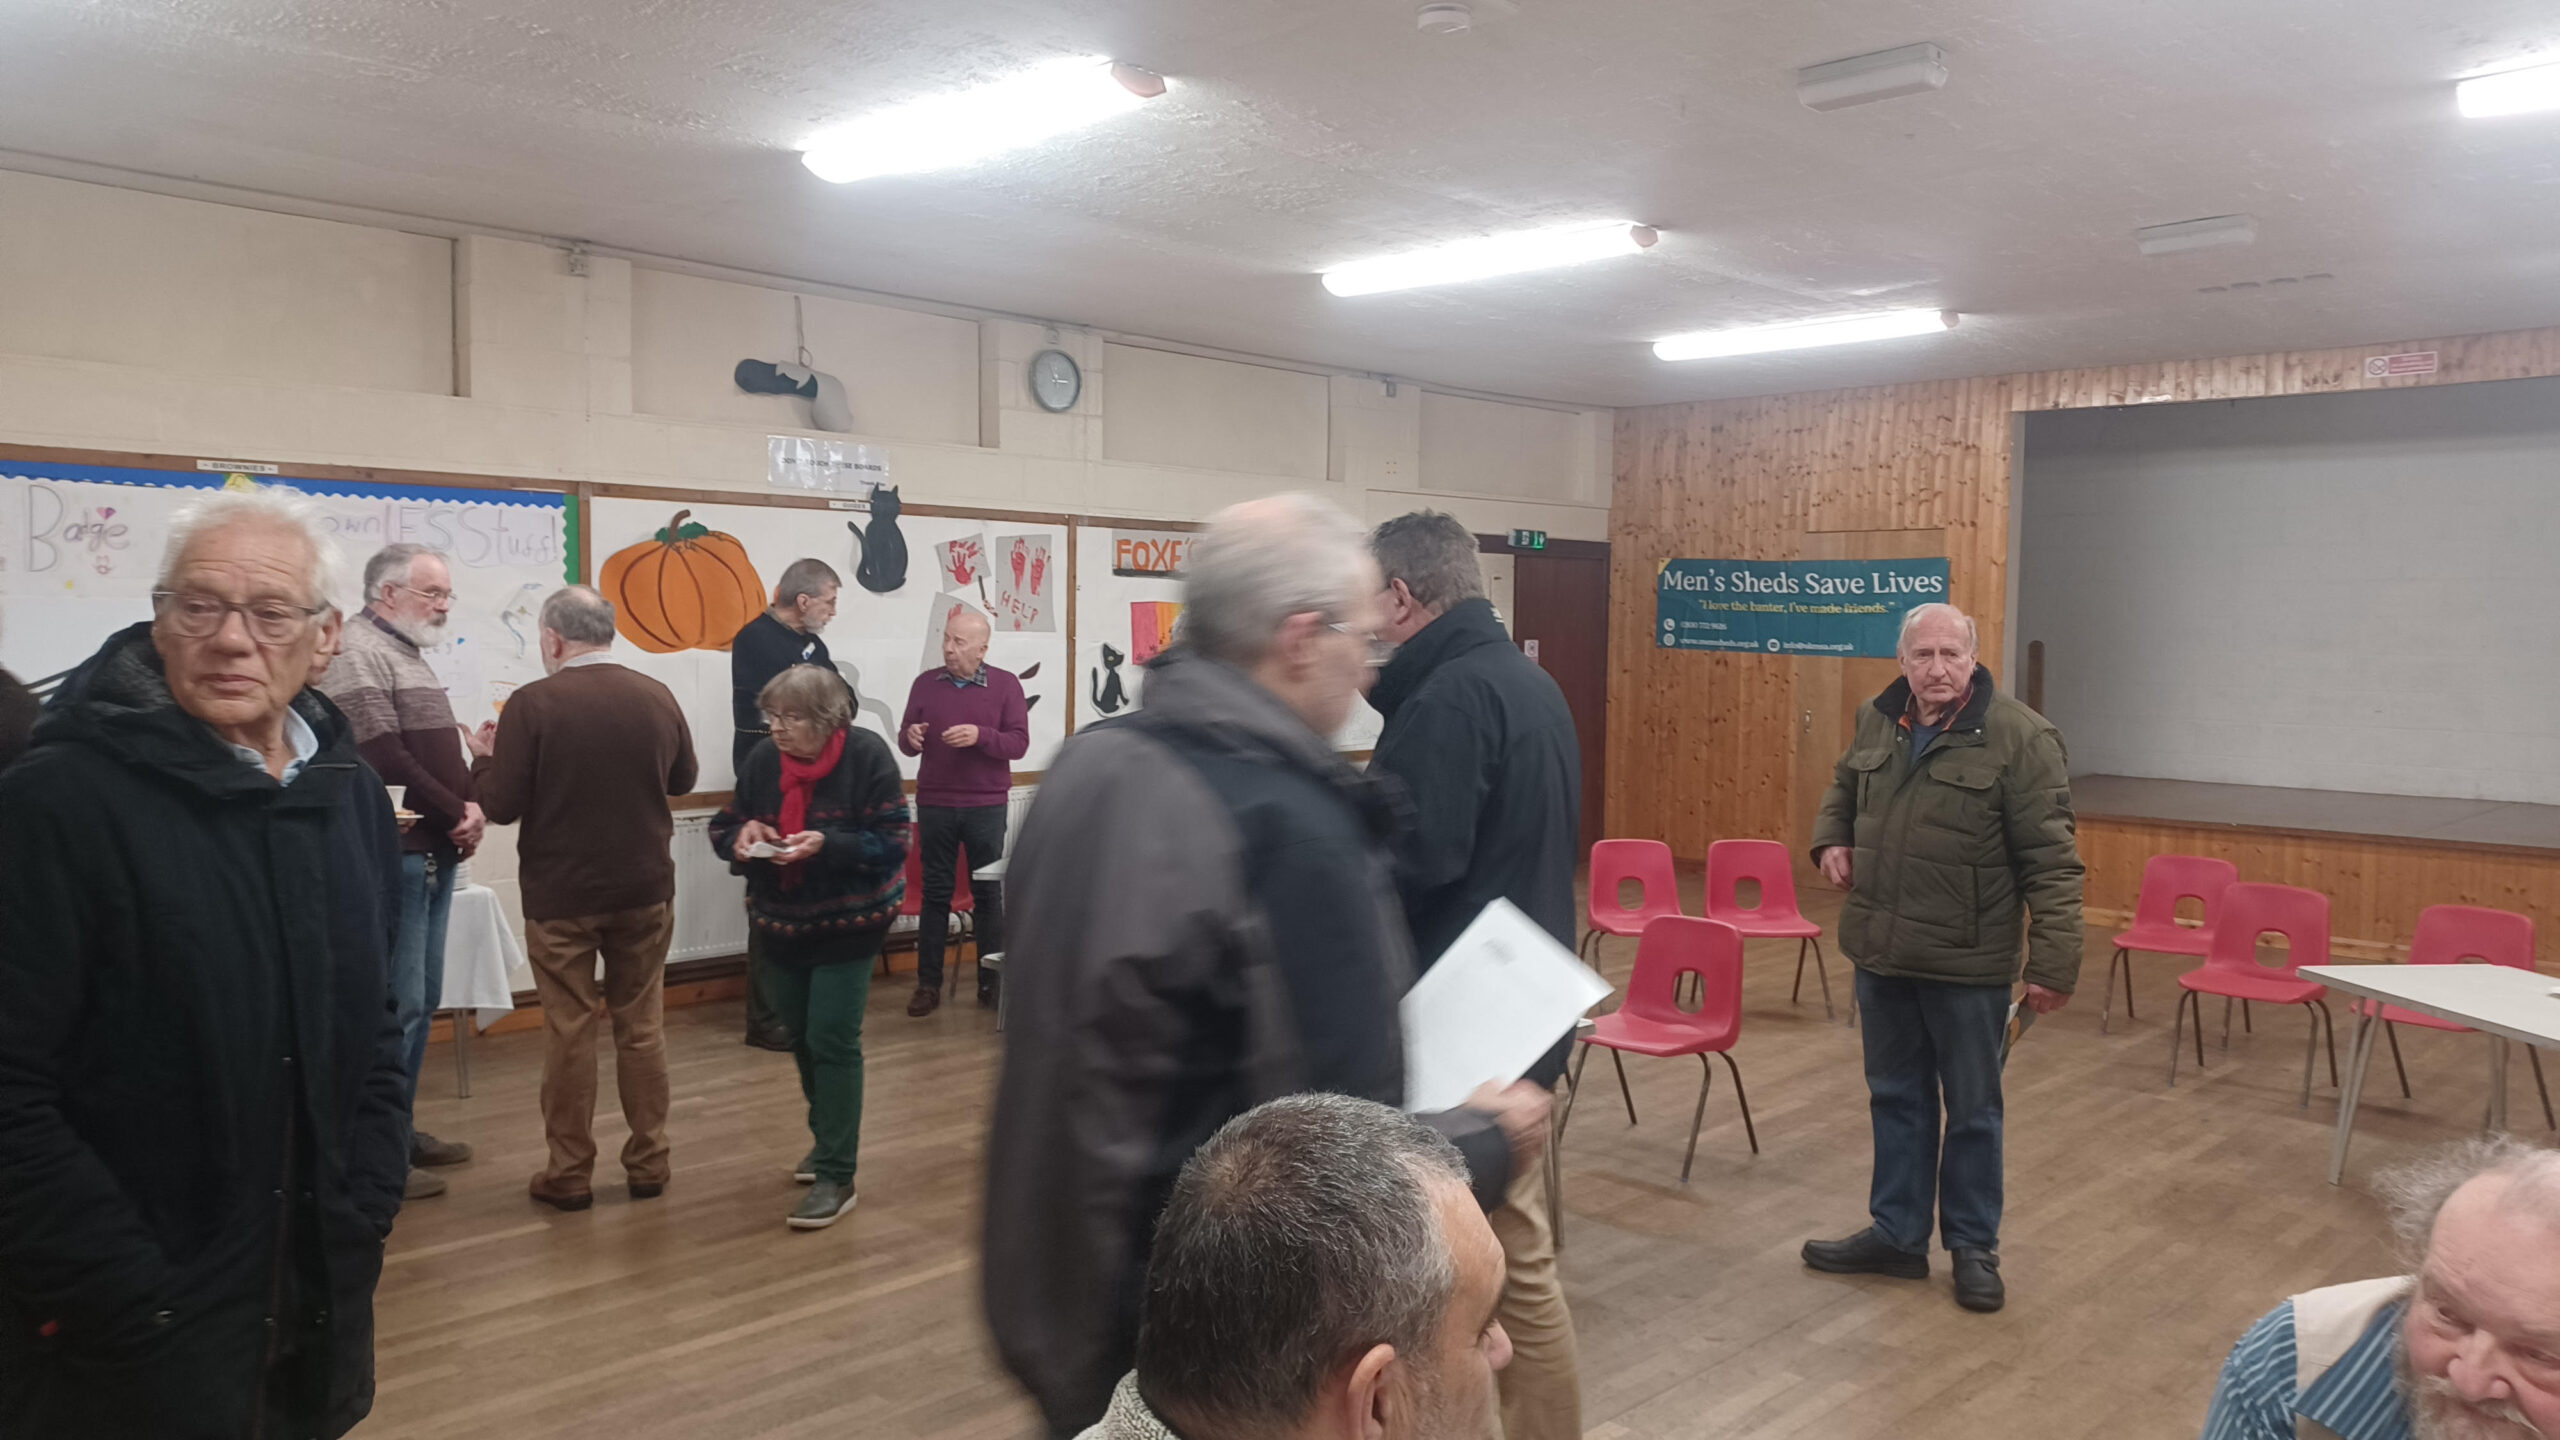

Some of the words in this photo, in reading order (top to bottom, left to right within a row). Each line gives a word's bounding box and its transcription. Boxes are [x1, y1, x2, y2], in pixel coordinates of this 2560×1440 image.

[212, 462, 265, 472] BROWNIES
[29, 484, 130, 571] Badge
[1663, 568, 1726, 592] Men's
[1730, 570, 1800, 594] Sheds
[1804, 572, 1866, 595] Save
[1871, 571, 1943, 593] Lives
[1001, 590, 1039, 624] HELP
[1708, 600, 1729, 611] love
[1731, 601, 1748, 611] the
[1789, 602, 1808, 613] I've
[1810, 602, 1842, 614] made
